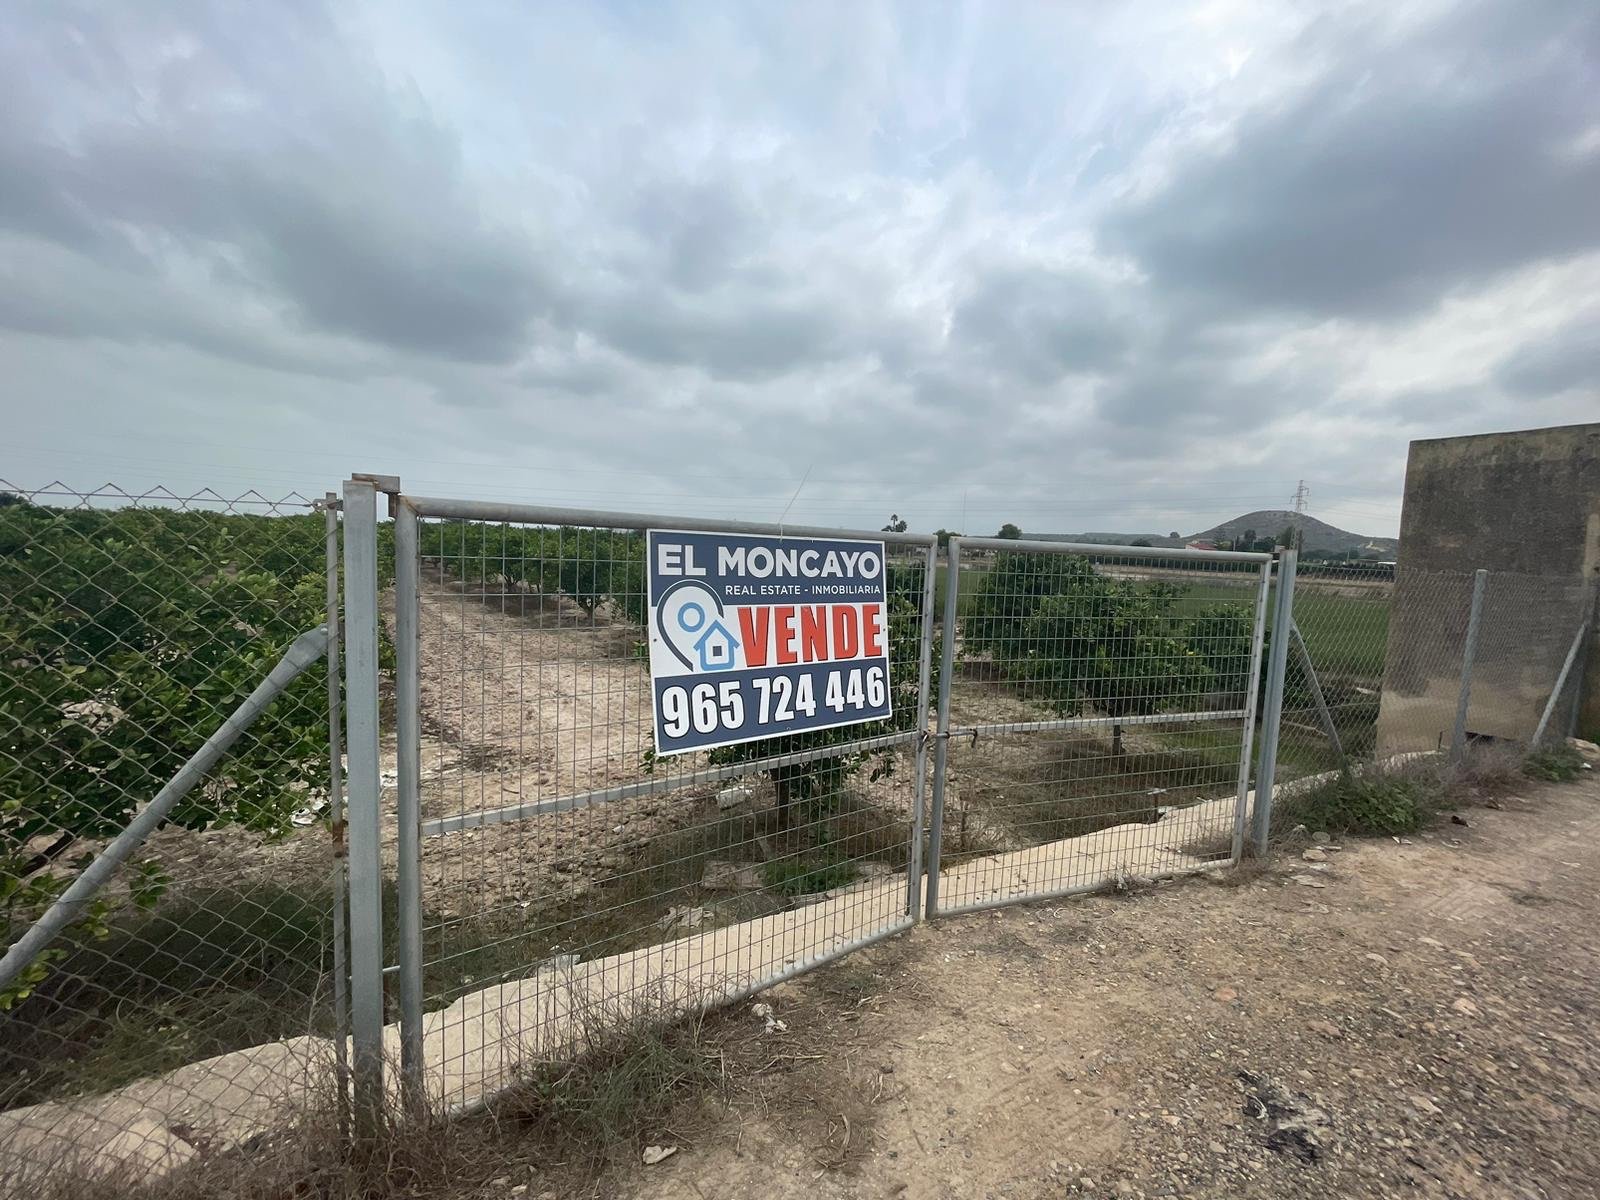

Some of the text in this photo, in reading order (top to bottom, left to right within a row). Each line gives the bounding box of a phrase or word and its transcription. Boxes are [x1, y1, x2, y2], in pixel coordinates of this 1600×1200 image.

[658, 543, 881, 579] EL MONCAYO
[725, 585, 757, 596] REAL
[760, 585, 801, 595] ESTATE
[812, 584, 881, 595] INMOBILIARIA
[737, 604, 883, 668] VENDE
[661, 666, 885, 739] 965 724 446
